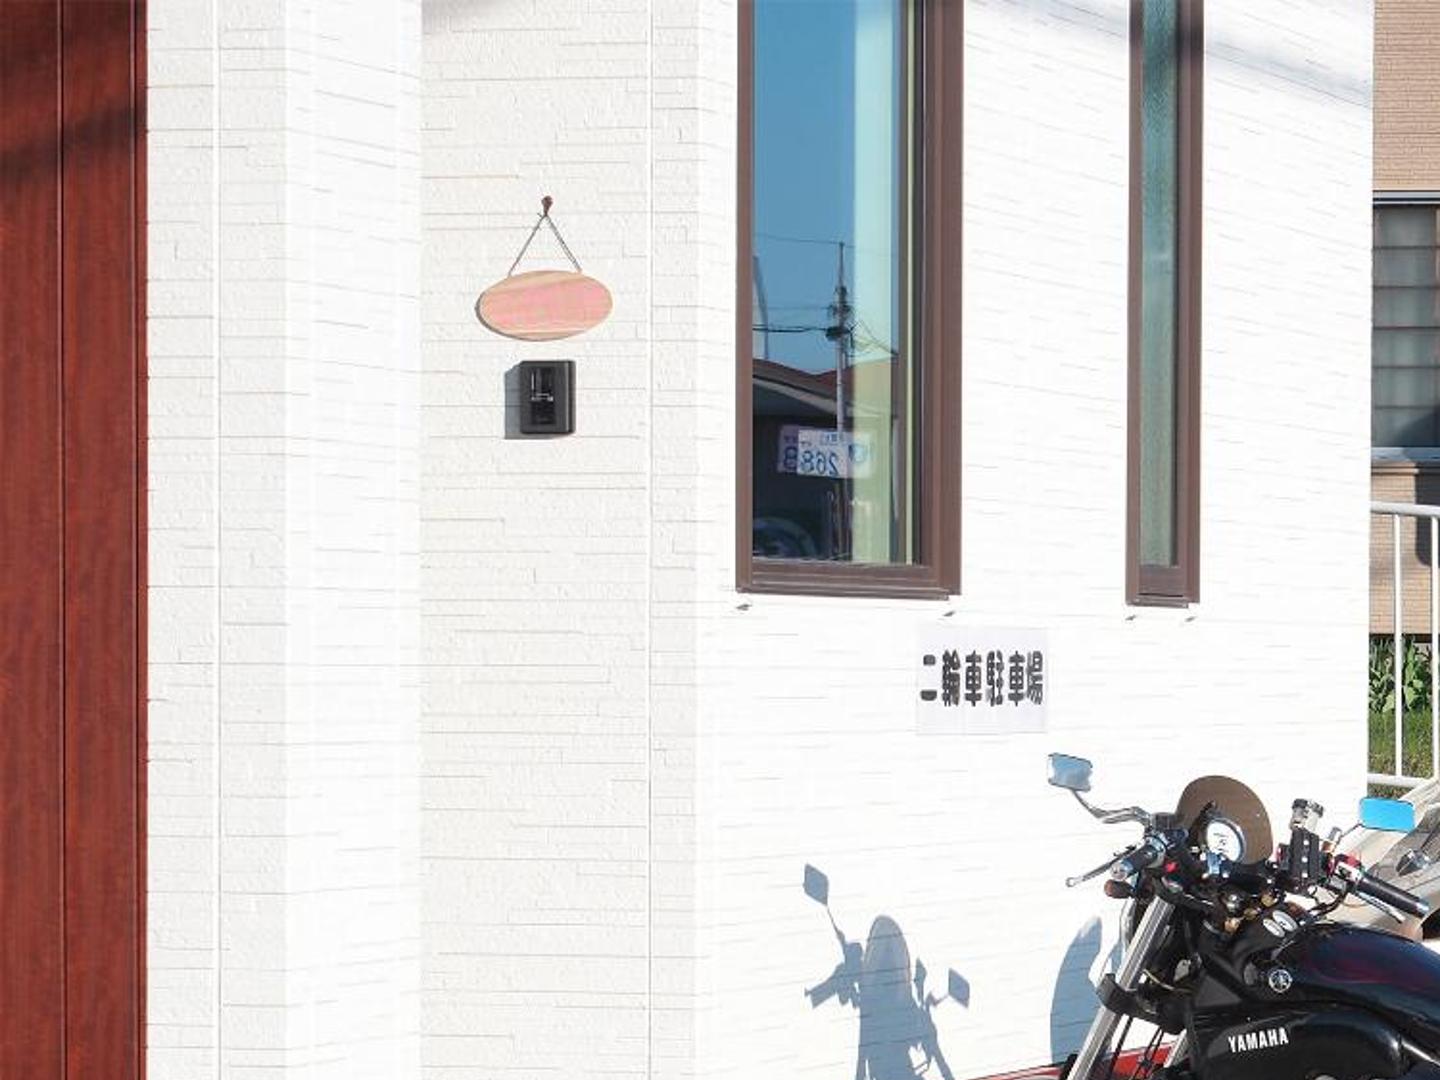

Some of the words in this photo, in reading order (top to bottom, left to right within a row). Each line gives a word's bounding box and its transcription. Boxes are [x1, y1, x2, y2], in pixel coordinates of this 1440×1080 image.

[920, 649, 1043, 707] 二輪車駐車場
[1228, 1027, 1289, 1053] YAMAHA
